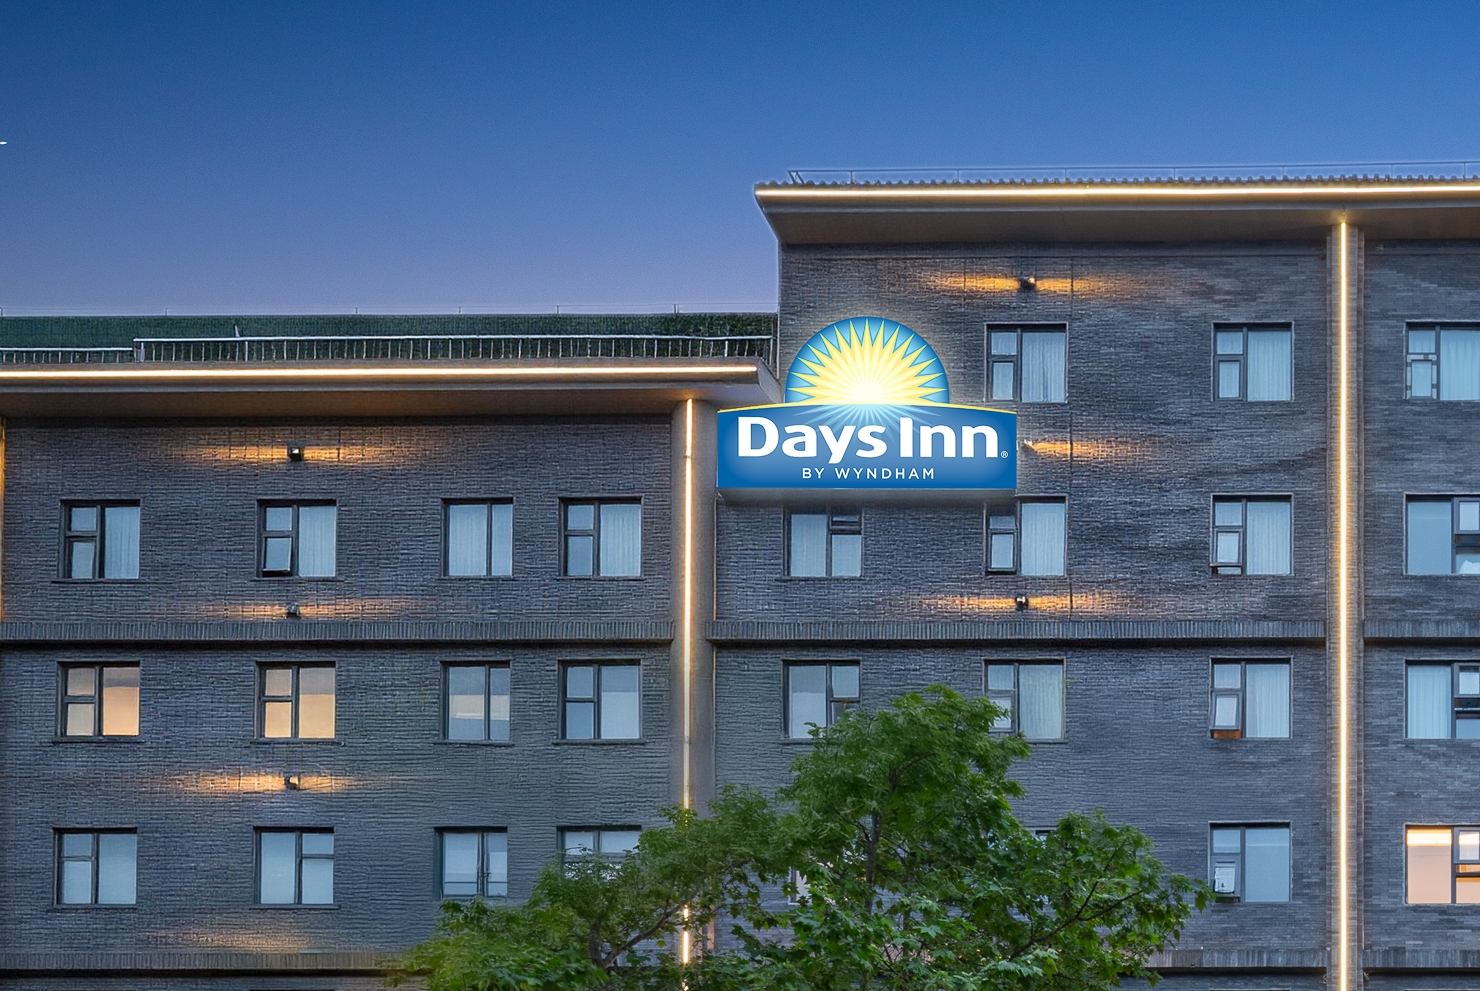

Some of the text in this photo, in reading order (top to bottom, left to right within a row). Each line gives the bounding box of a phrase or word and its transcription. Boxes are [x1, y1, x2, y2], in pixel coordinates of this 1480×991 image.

[738, 416, 887, 464] Days
[802, 467, 935, 480] BY WYNDHAM
